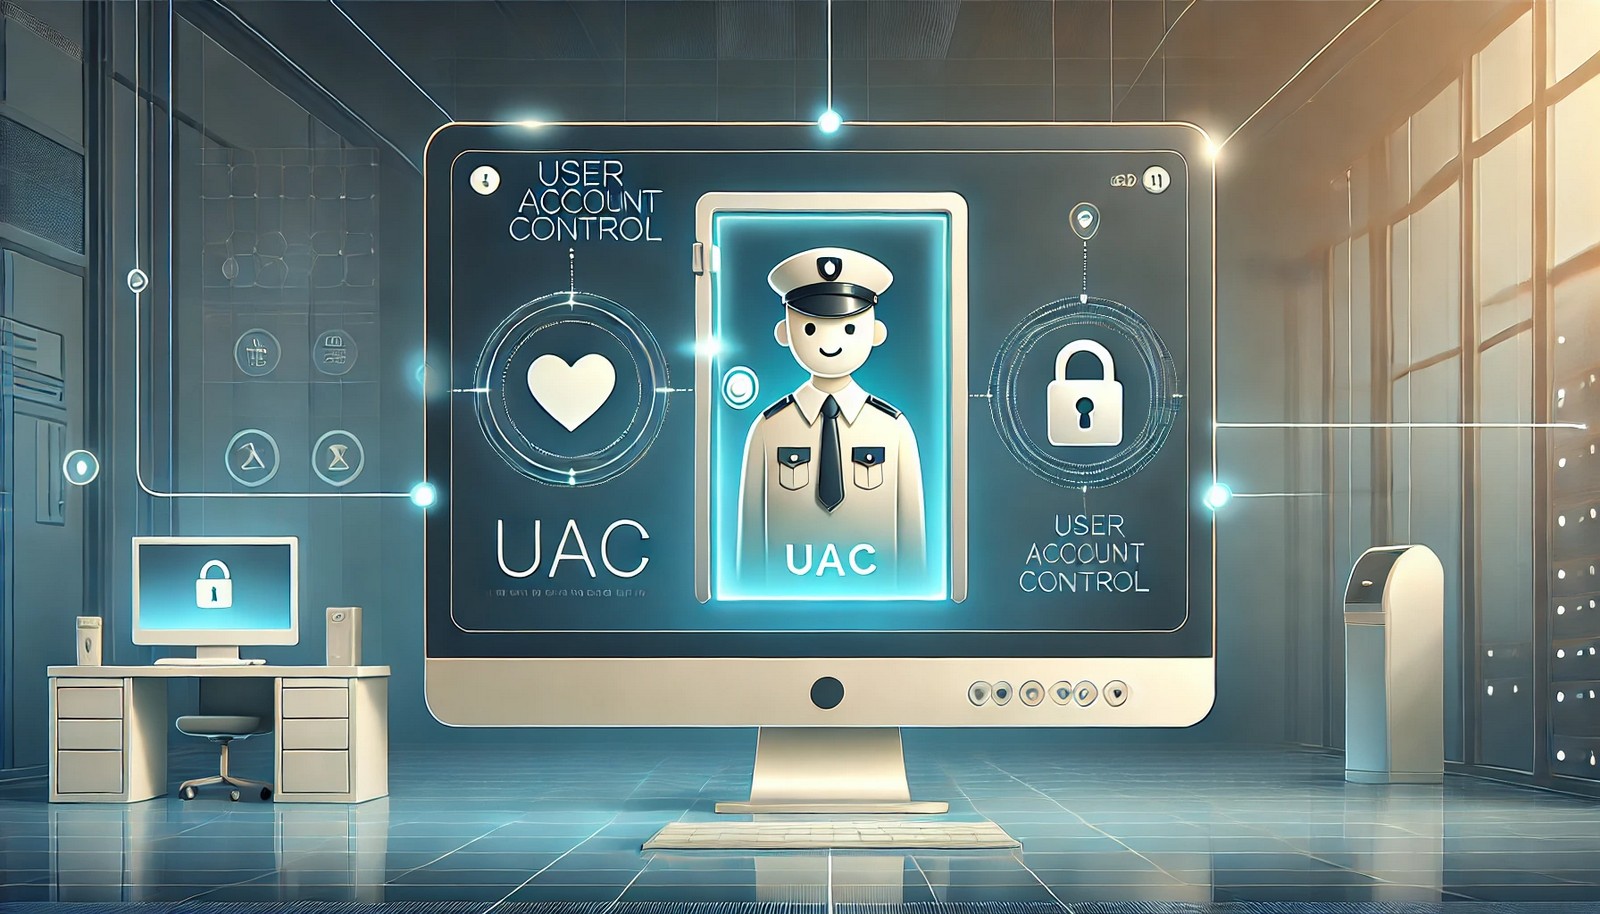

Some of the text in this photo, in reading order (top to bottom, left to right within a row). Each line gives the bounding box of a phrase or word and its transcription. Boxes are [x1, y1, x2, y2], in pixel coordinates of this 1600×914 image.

[538, 160, 623, 187] USER
[518, 188, 664, 215] ACCOUNT
[509, 216, 663, 242] CONTROL
[1055, 514, 1125, 537] USER
[497, 519, 650, 578] UAC
[786, 543, 877, 577] UAC
[1019, 570, 1150, 593] CONTROL
